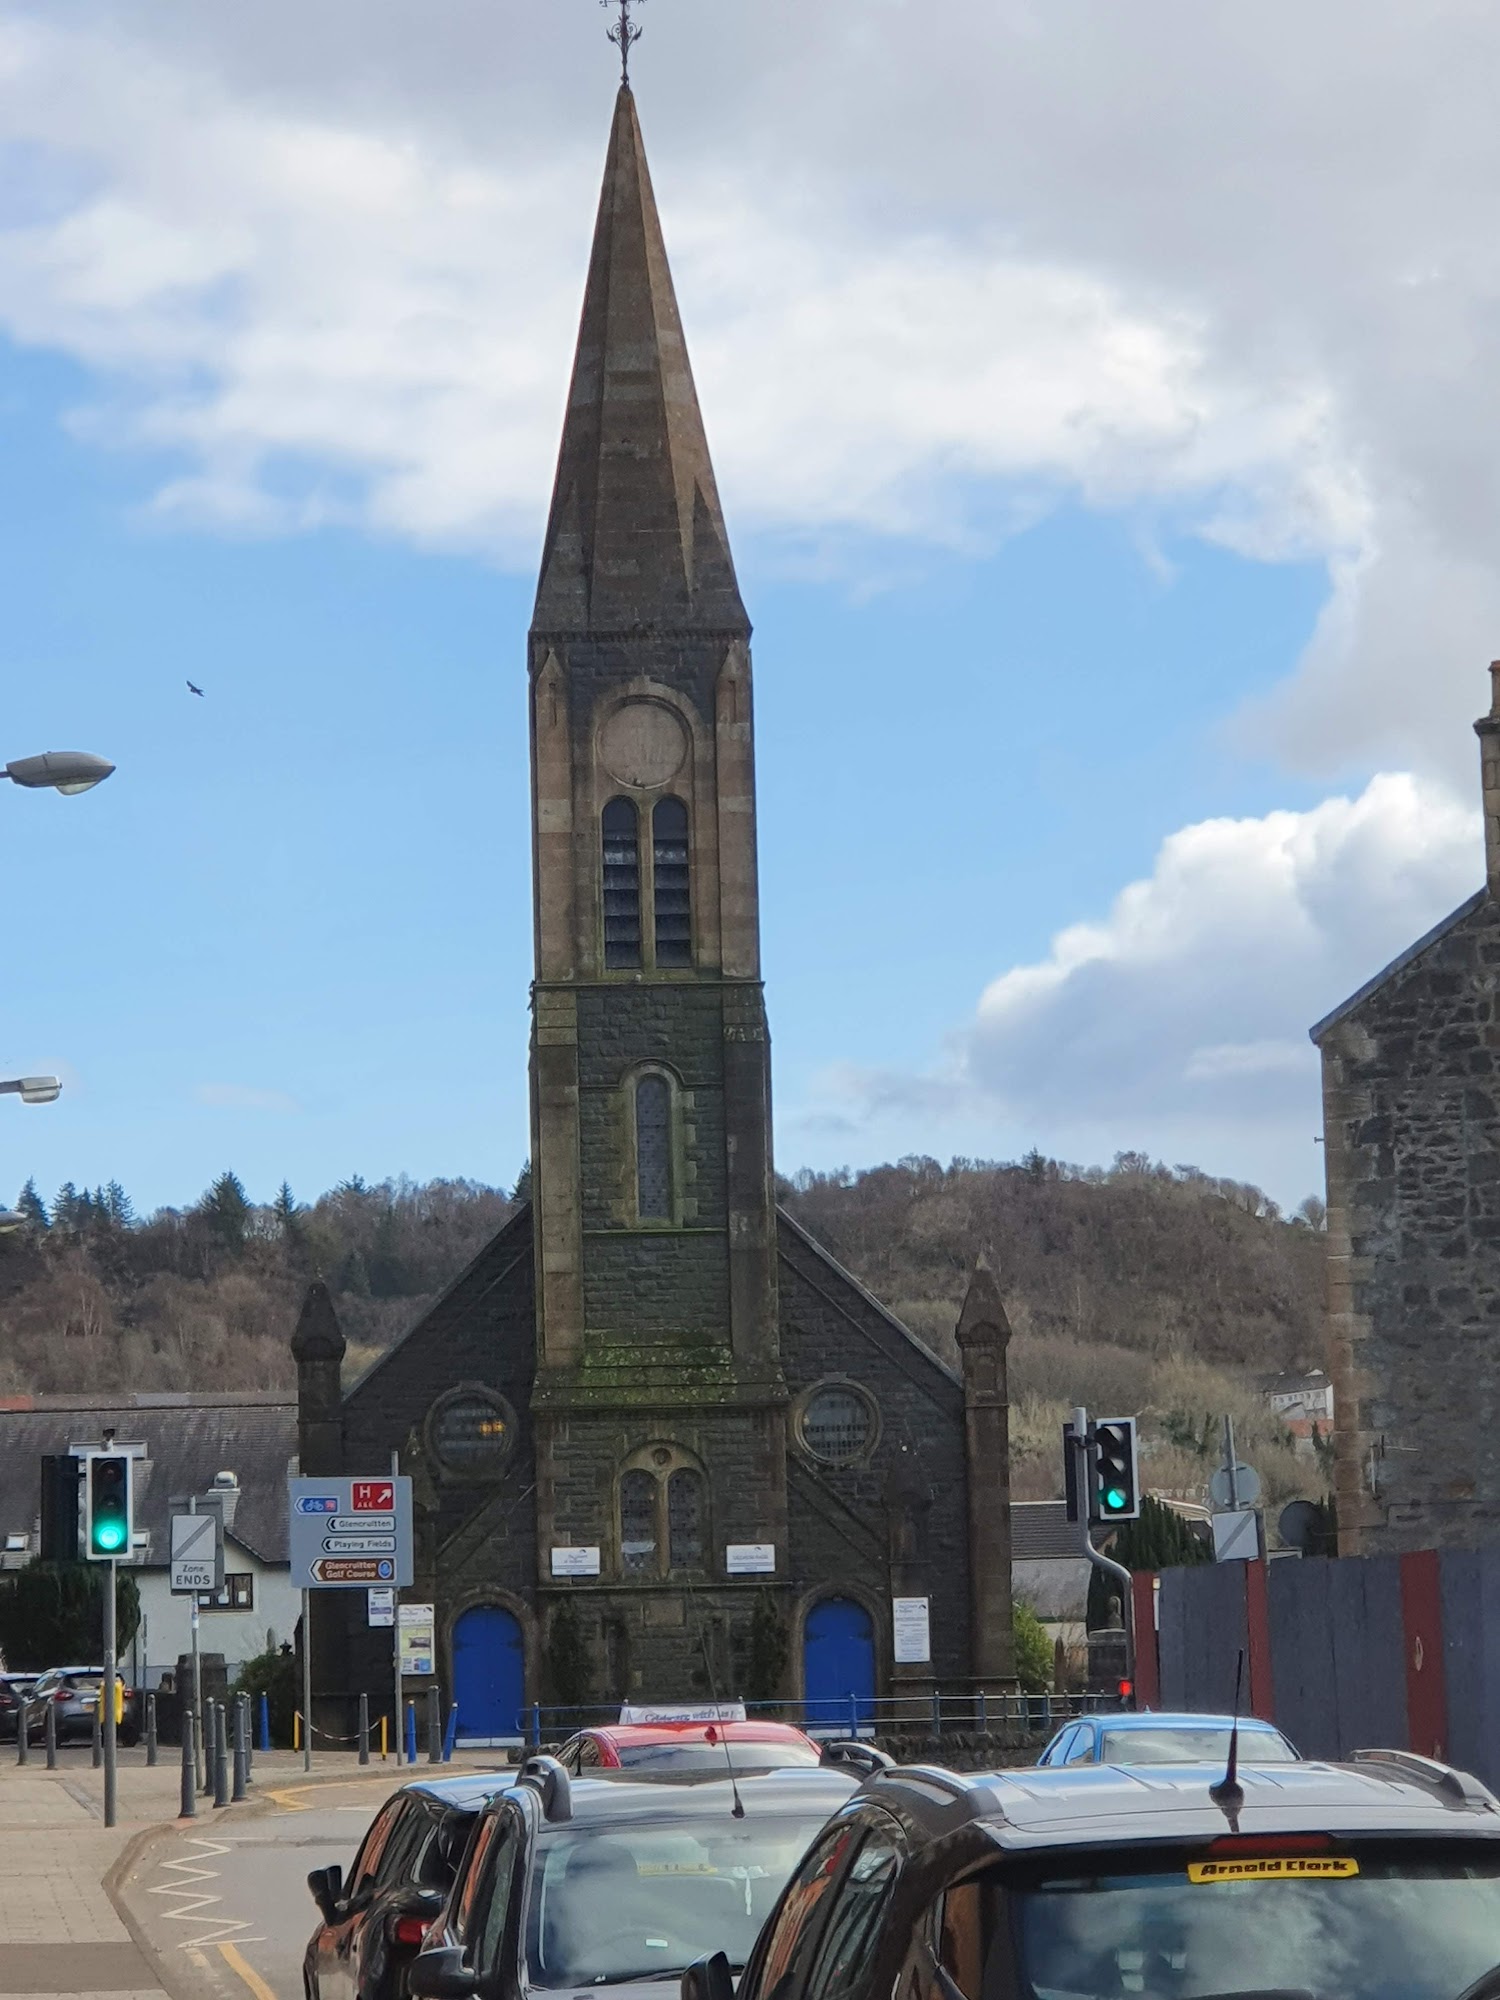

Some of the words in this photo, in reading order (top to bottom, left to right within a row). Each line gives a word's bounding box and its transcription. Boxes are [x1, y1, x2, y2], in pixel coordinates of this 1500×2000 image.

[359, 1485, 371, 1499] H
[339, 1519, 391, 1528] Glencruitten
[334, 1540, 364, 1549] Playing
[367, 1540, 391, 1548] Fields
[182, 1564, 205, 1573] Zone
[325, 1561, 377, 1570] Glencruitten
[325, 1569, 344, 1578] Golf
[346, 1569, 376, 1578] Course
[176, 1574, 211, 1585] ENDS
[1200, 1860, 1282, 1876] Arnold
[1286, 1860, 1349, 1871] Clark
